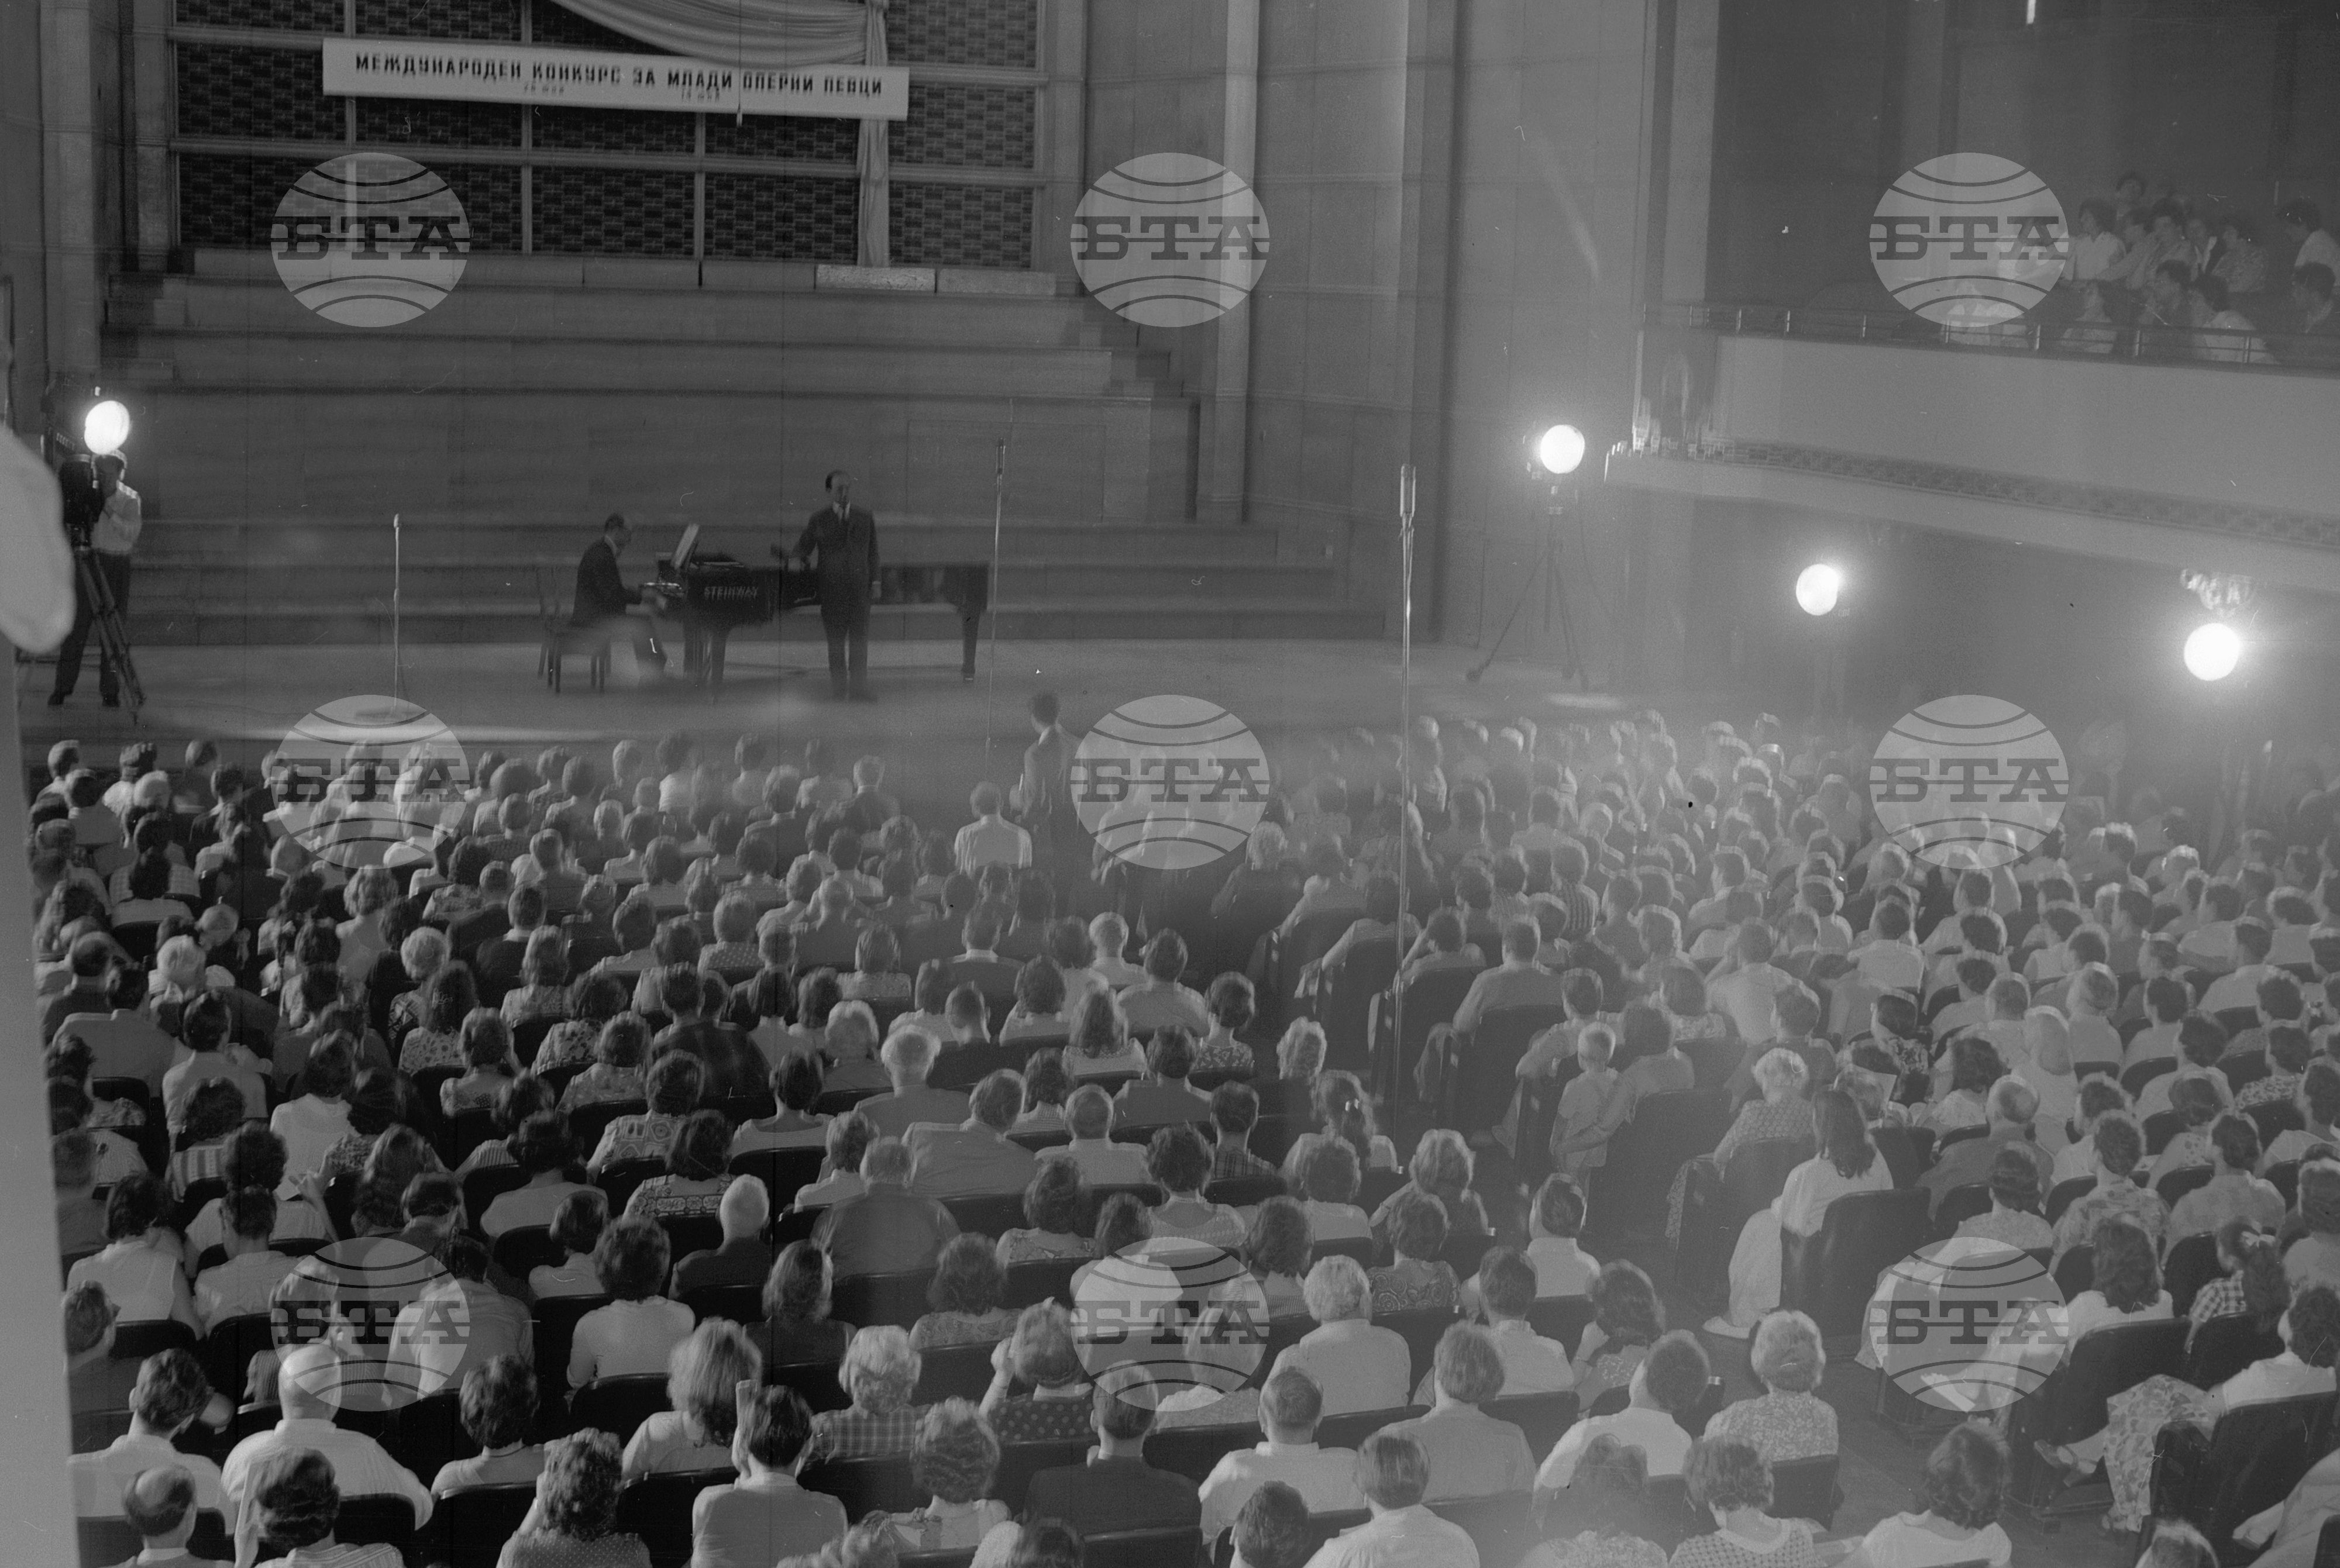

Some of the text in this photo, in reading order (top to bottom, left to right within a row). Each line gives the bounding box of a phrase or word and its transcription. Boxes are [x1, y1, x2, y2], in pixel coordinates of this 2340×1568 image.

[355, 53, 882, 98] МЕЖДУНАРОДЕН КОНКУРС ЗА МЛАДИ ОПЕРНИ ПЕВЦИ
